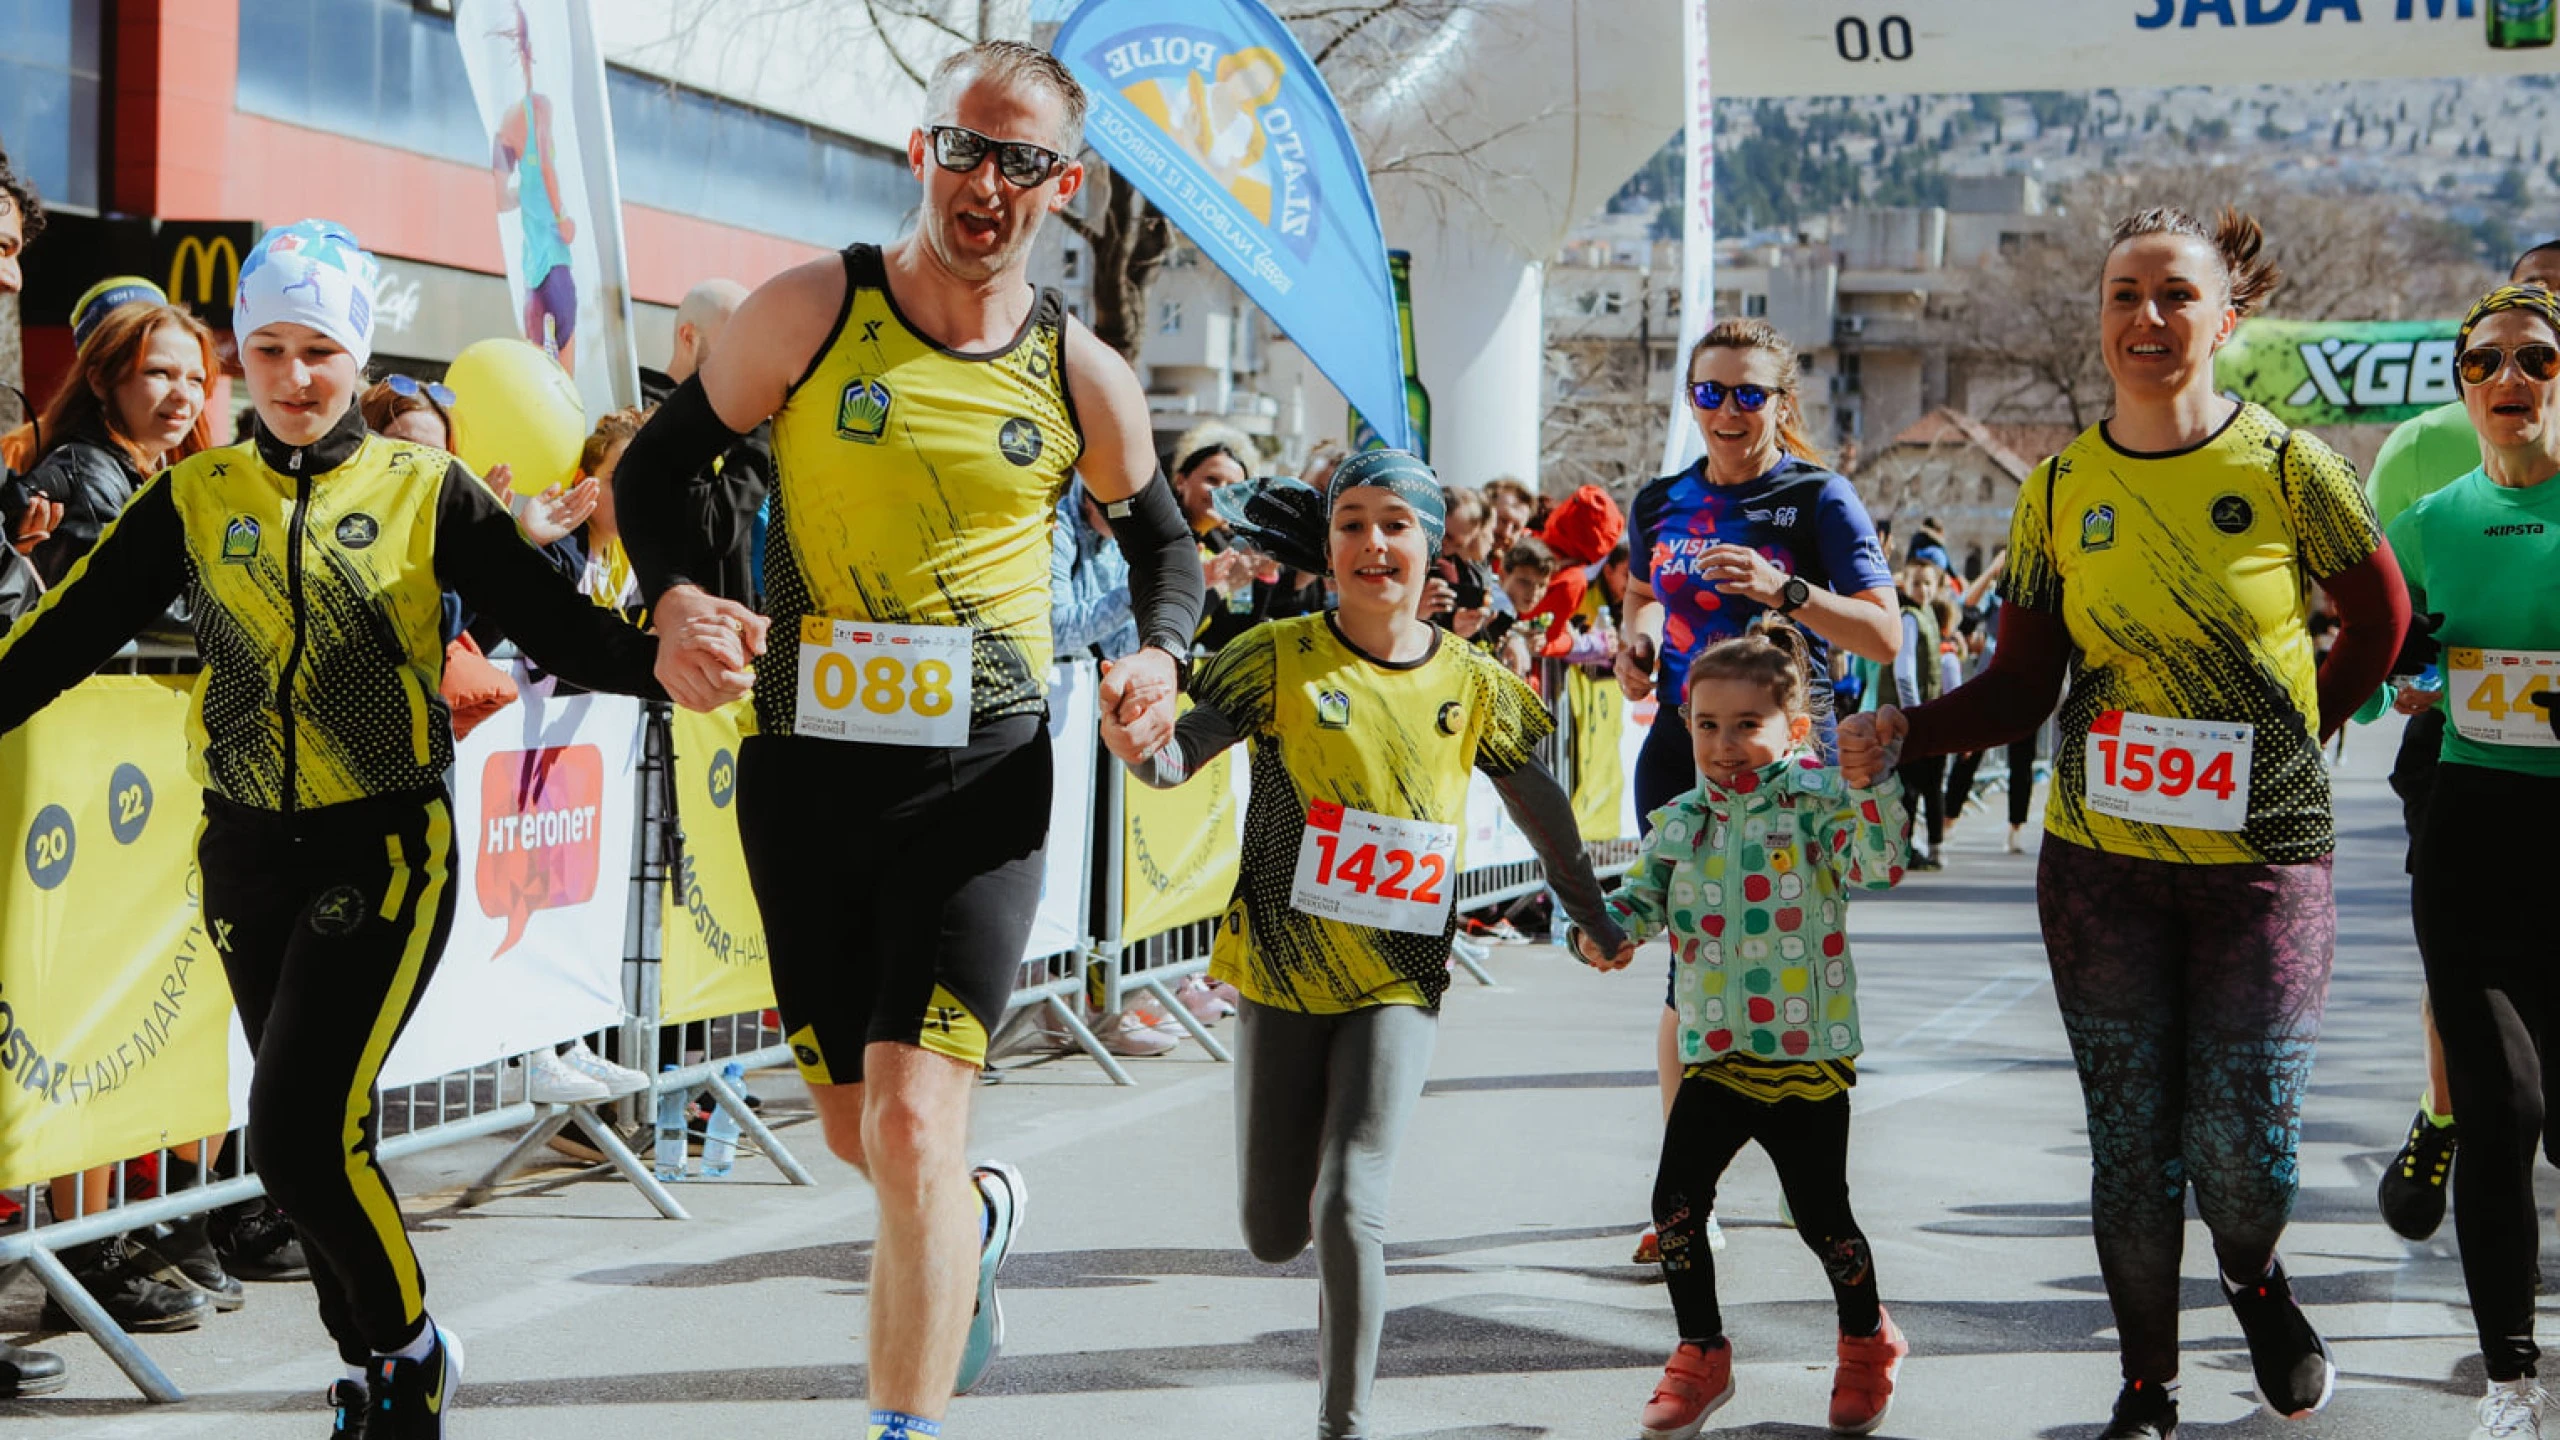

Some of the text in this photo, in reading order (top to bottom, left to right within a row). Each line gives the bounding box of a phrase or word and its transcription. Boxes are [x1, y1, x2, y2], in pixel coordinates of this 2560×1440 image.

[1668, 537, 1721, 555] VISIT
[812, 651, 954, 718] 088
[2466, 673, 2560, 723] 44
[714, 763, 732, 795] 20
[2097, 740, 2237, 801] 1594
[118, 785, 145, 826] 22
[36, 828, 68, 870] 20
[1315, 834, 1446, 905] 1422
[682, 854, 769, 967] MOSTAR HAL
[0, 982, 68, 1104] OSTAR
[70, 1043, 134, 1107] HALF
